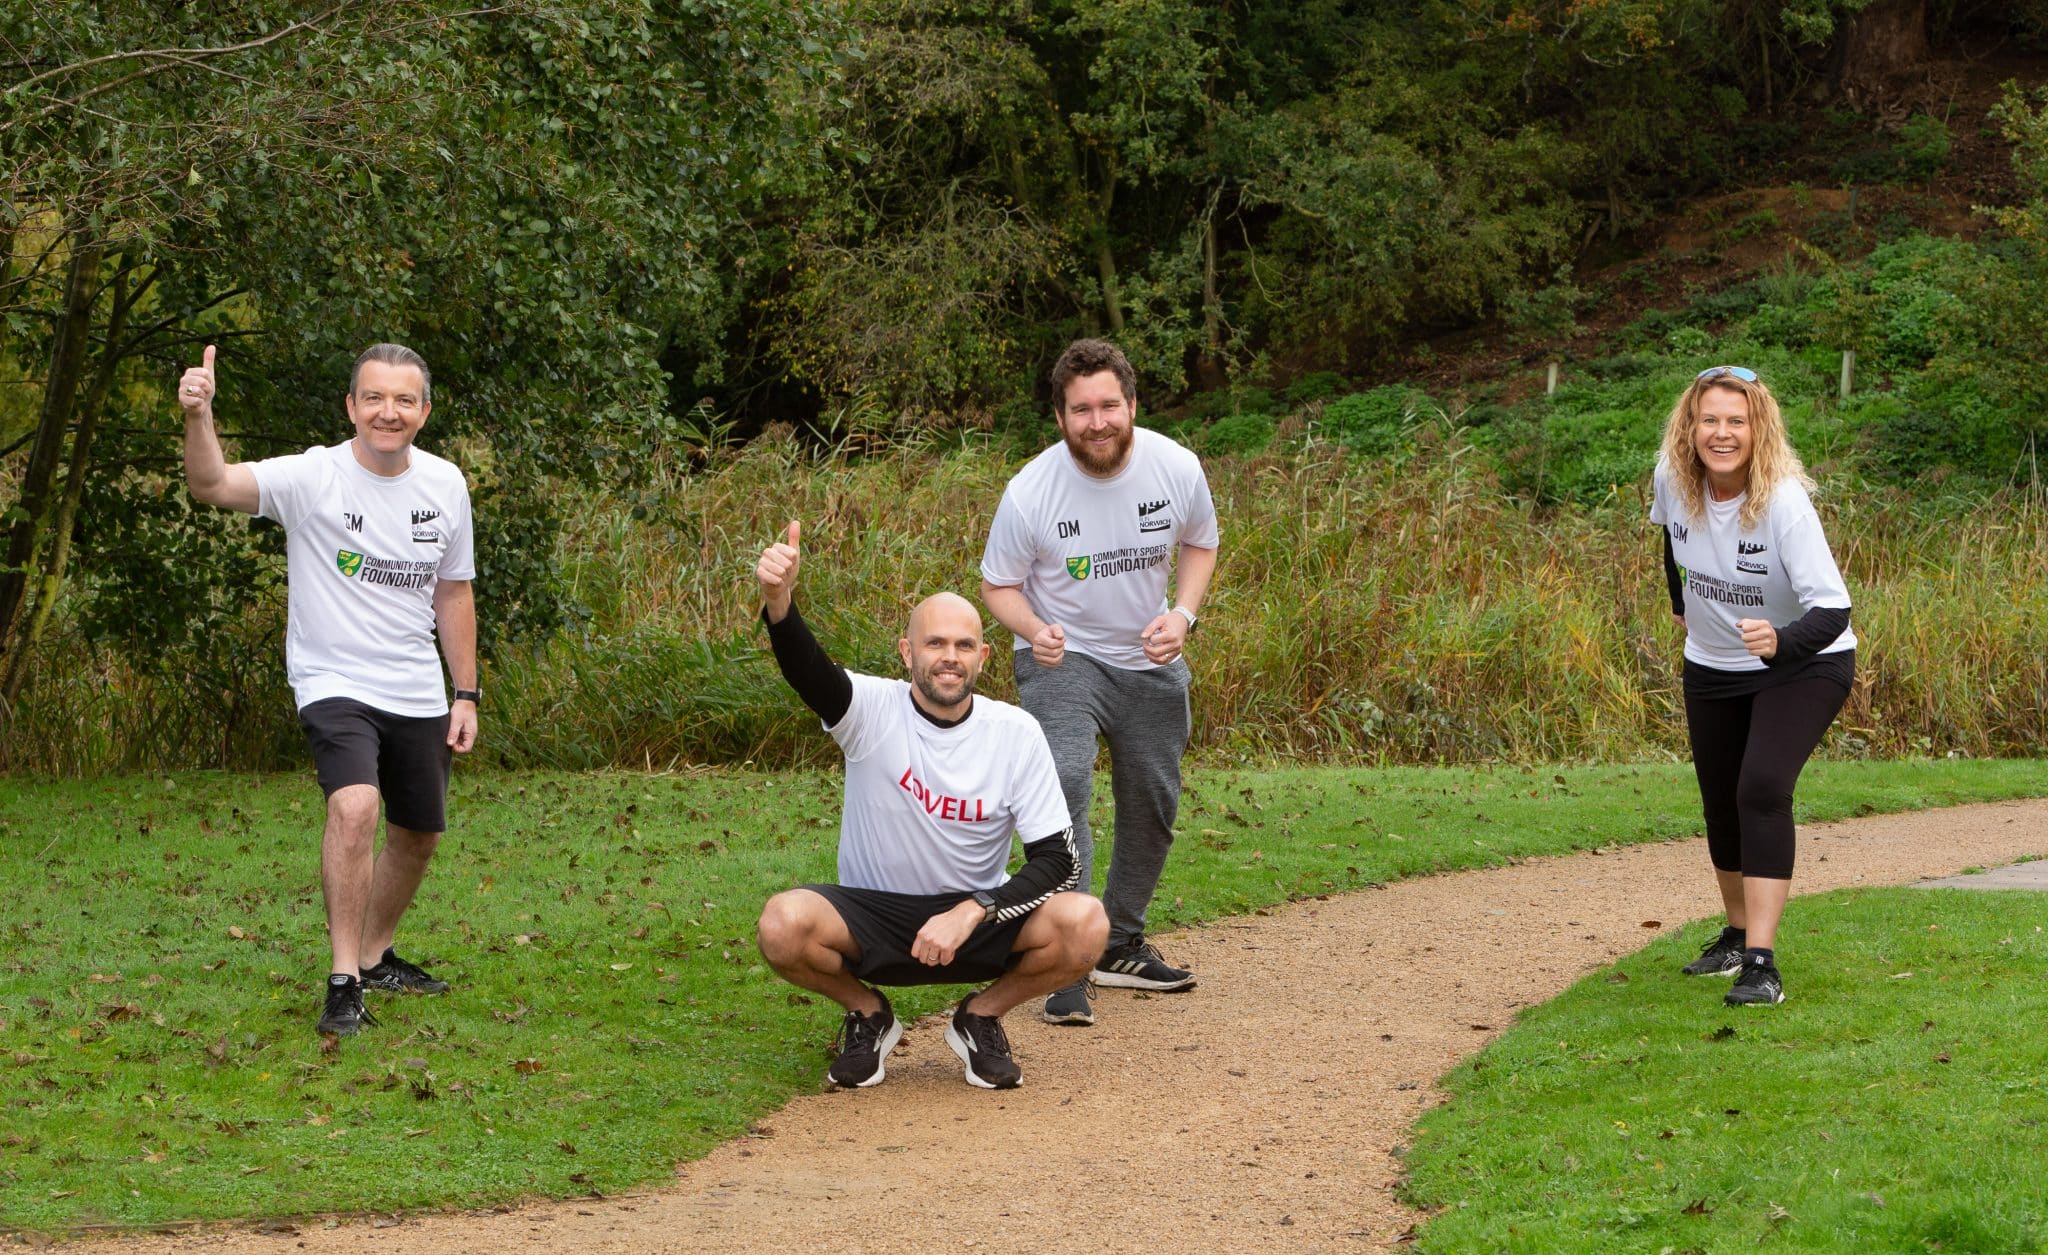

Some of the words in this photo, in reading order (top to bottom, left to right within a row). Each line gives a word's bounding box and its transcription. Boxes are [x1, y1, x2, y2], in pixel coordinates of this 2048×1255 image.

[1058, 520, 1080, 538] DM
[1139, 519, 1171, 528] NORWICH
[1673, 522, 1688, 544] DM
[1093, 548, 1138, 563] COMMUNITY
[1140, 544, 1167, 556] SPORTS
[365, 557, 413, 571] COMMUNITY
[413, 561, 438, 572] SPORT
[1094, 553, 1167, 579] FOUNDATION
[1737, 560, 1768, 570] NORWICH
[1688, 569, 1729, 590] COMMUNITY
[1731, 583, 1762, 594] SPORTS
[1690, 580, 1764, 606] FOUNDATION
[899, 767, 990, 822] LOVELL
